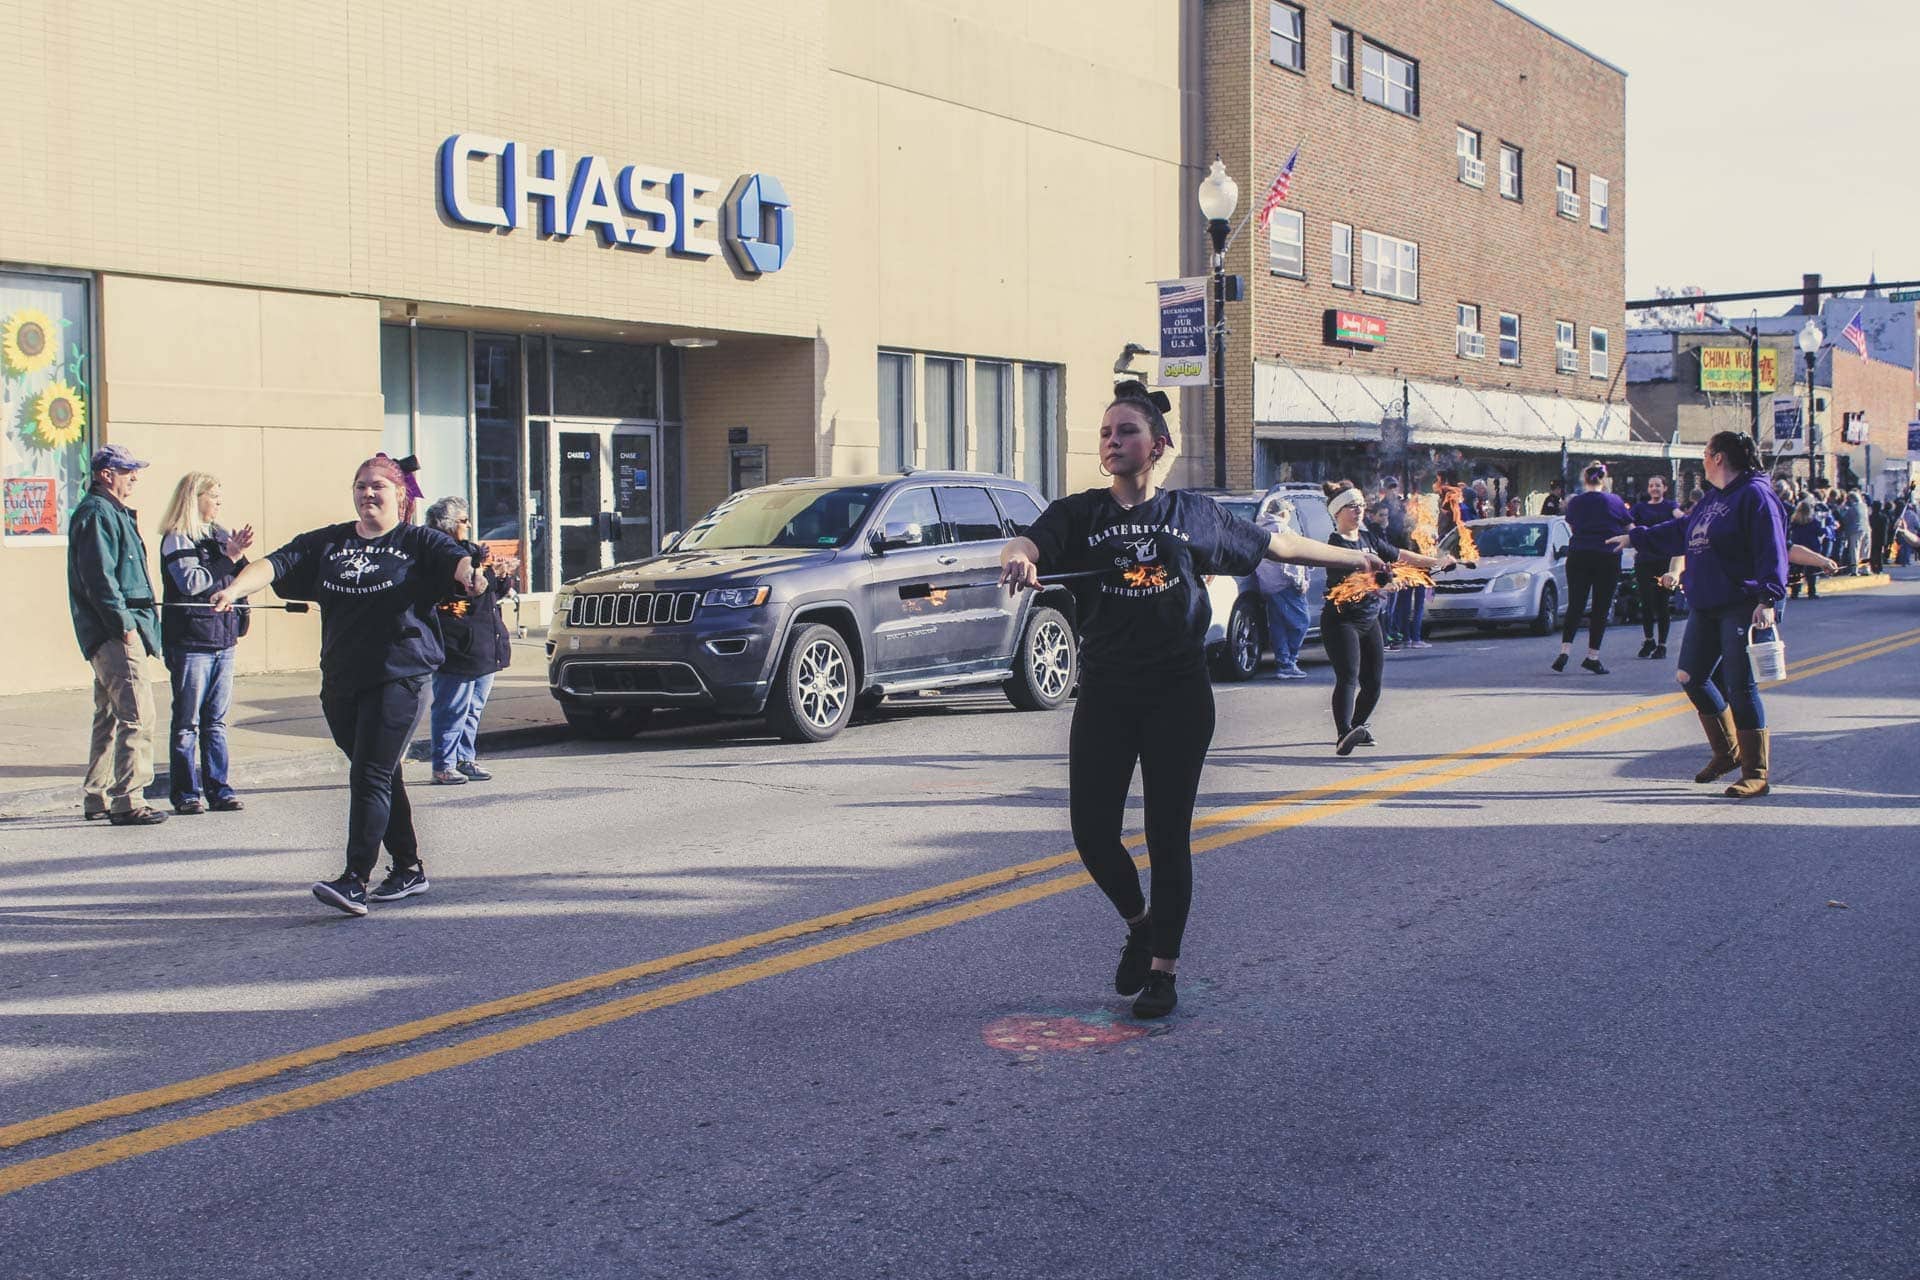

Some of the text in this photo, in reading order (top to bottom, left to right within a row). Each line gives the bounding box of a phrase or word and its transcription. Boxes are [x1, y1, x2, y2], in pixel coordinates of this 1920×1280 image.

[442, 134, 724, 257] CHASE
[1704, 350, 1731, 368] CHINA
[1131, 524, 1190, 542] RIVALS
